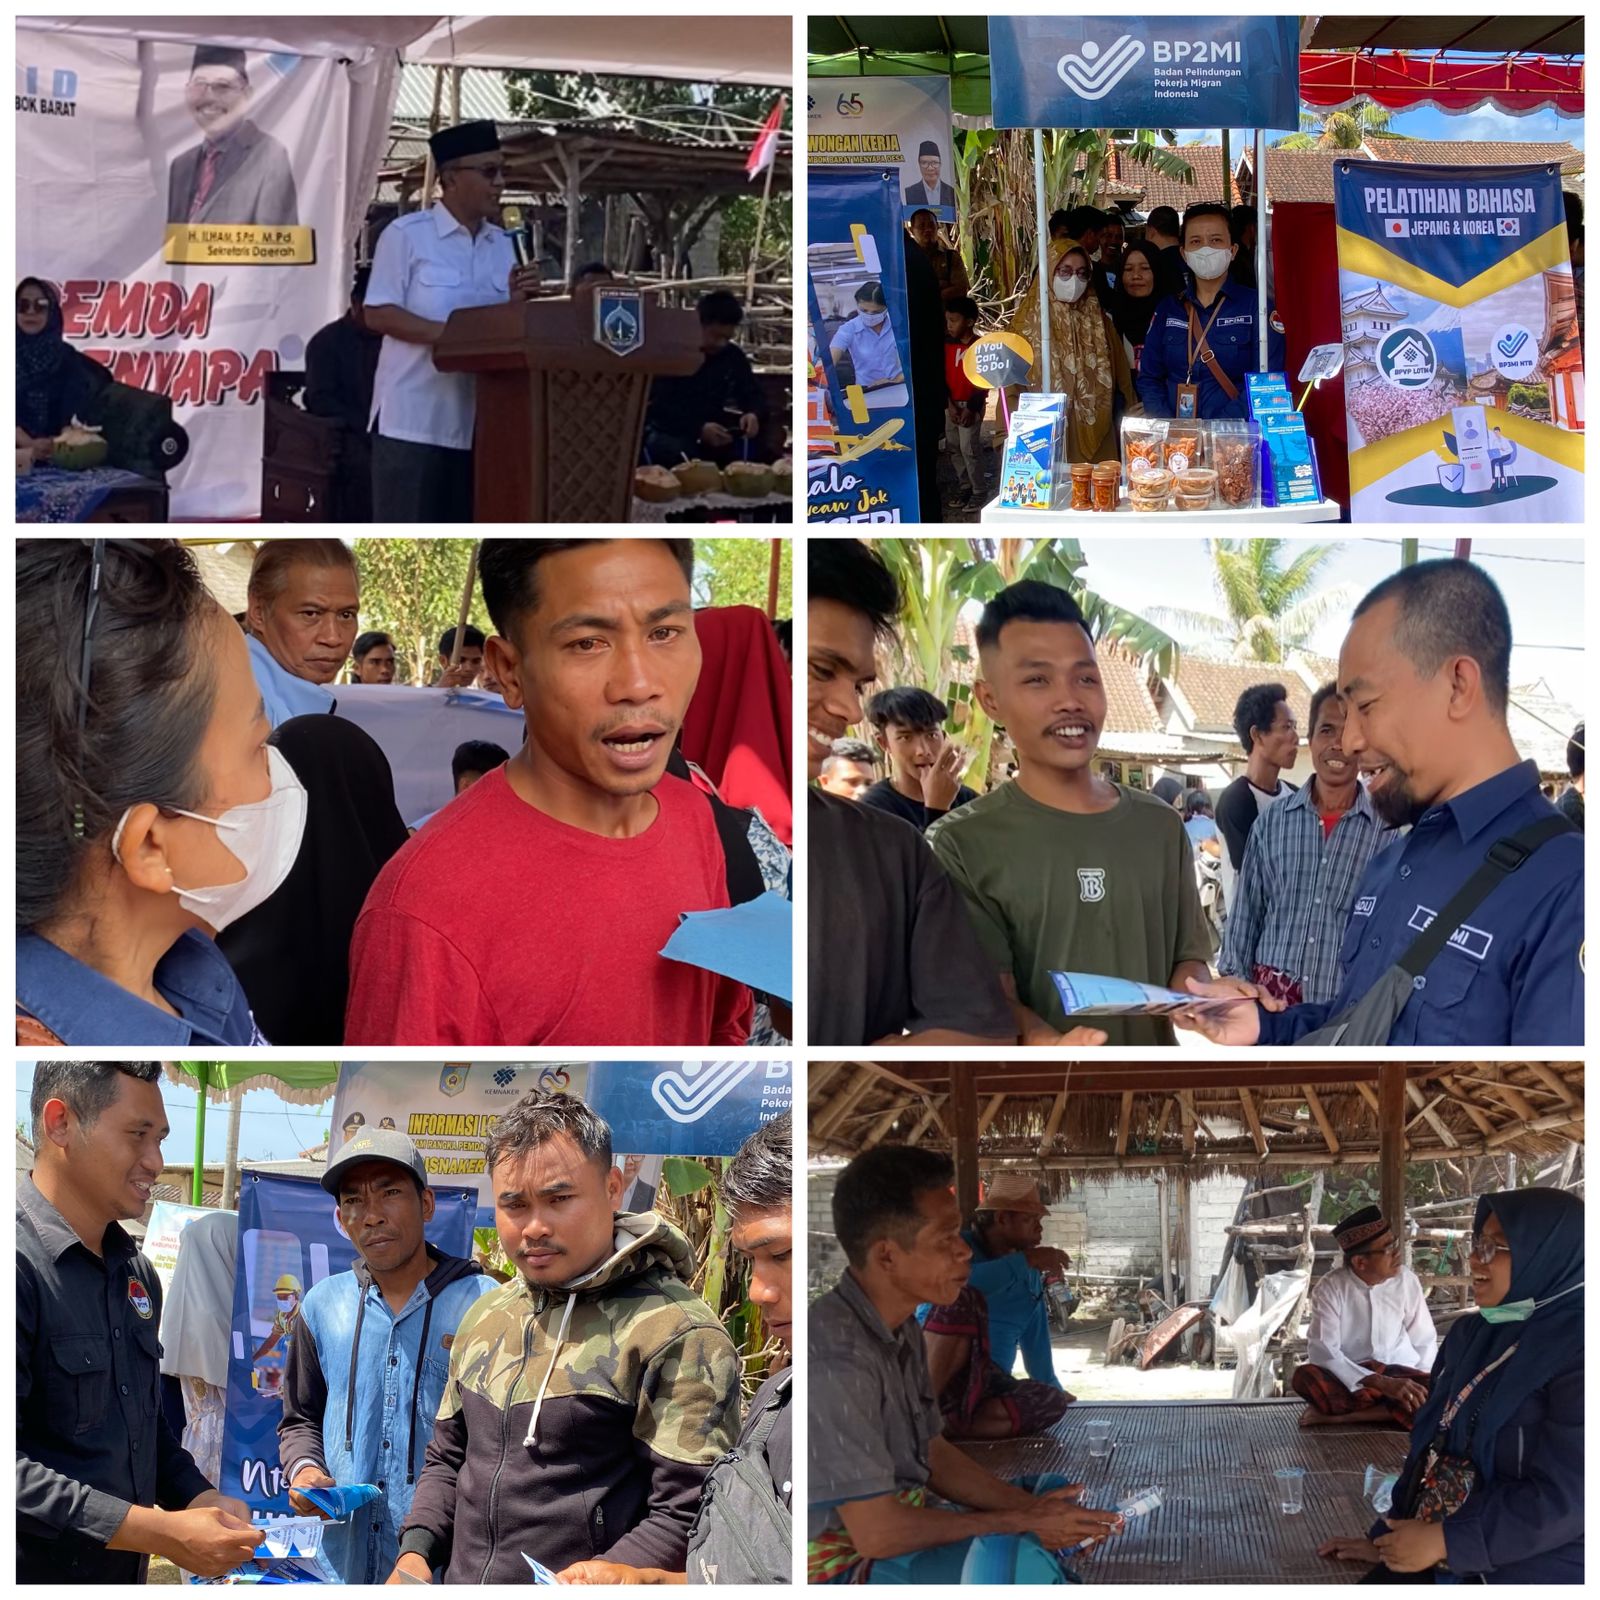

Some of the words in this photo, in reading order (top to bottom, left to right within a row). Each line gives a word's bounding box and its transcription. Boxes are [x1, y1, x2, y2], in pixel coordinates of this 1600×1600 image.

[1153, 41, 1241, 63] BP2MI
[1154, 68, 1183, 76] Badan
[1185, 67, 1242, 77] Pelindungan
[1154, 79, 1188, 88] Pekerja
[1190, 79, 1222, 88] Migran
[1154, 90, 1199, 98] Indonesia
[40, 99, 76, 117] BARAT
[860, 134, 901, 152] KERJA
[1364, 187, 1463, 214] PELATIHAN
[1466, 188, 1536, 214] BAHASA
[1411, 220, 1450, 236] JEPANG
[1453, 221, 1460, 235] &
[1462, 220, 1495, 235] KOREA
[251, 246, 296, 258] Daerah
[60, 280, 212, 340] EMDA
[982, 342, 1003, 353] You
[990, 360, 1005, 371] Do
[857, 488, 889, 512] Jok
[484, 1088, 520, 1096] KEMNAKER
[408, 1113, 480, 1136] INFORMASI
